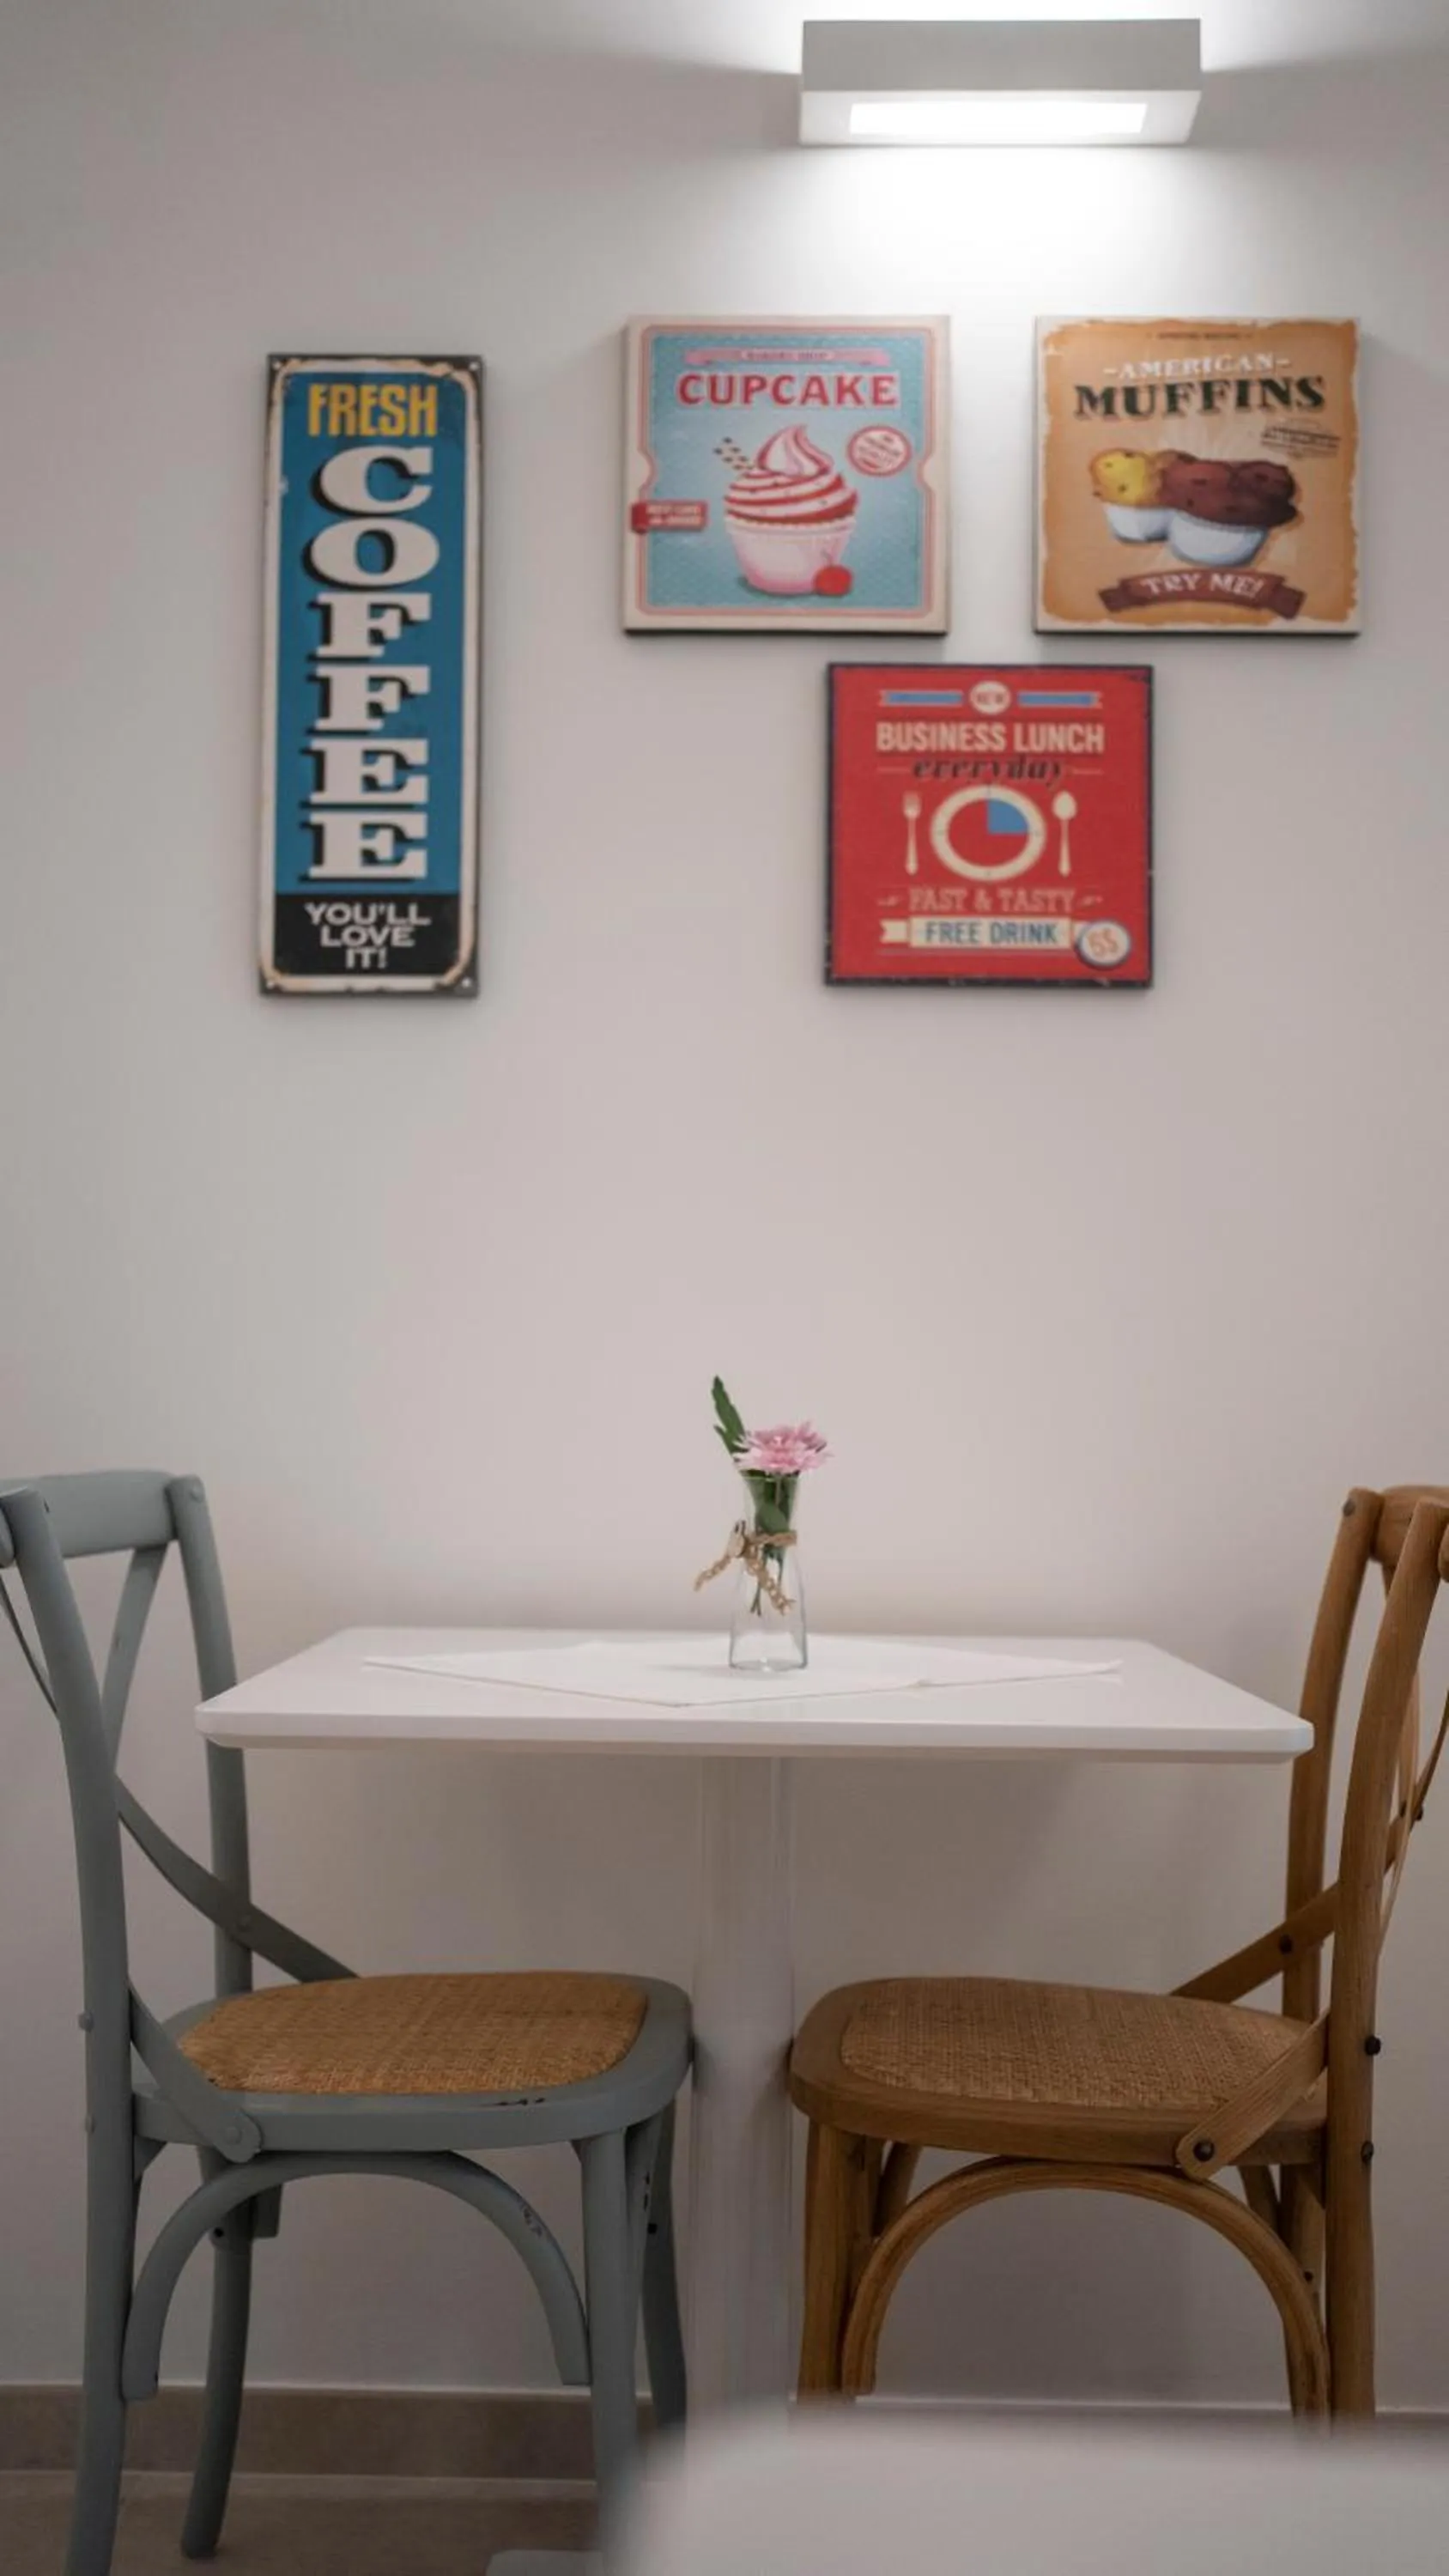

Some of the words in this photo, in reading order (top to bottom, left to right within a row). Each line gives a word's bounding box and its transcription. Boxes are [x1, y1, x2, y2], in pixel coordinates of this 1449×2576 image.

[1119, 352, 1274, 380] AMERICAN
[676, 373, 900, 408] CUPCAKE
[1073, 375, 1326, 421] MUFFINS
[307, 383, 438, 437] FRESH
[1140, 572, 1201, 596] TRY
[1210, 573, 1264, 599] ME!
[300, 445, 440, 883] COFFEE
[876, 720, 1007, 753] BUSINESS
[1013, 722, 1106, 754] LUNCH
[907, 887, 967, 913] FAST
[973, 889, 992, 912] &
[997, 888, 1076, 913] TASTY
[305, 902, 432, 926] YOU'LL
[319, 926, 415, 947] LOVE
[924, 921, 983, 945] FREE
[989, 921, 1058, 945] DRINK
[345, 948, 388, 969] IT!
